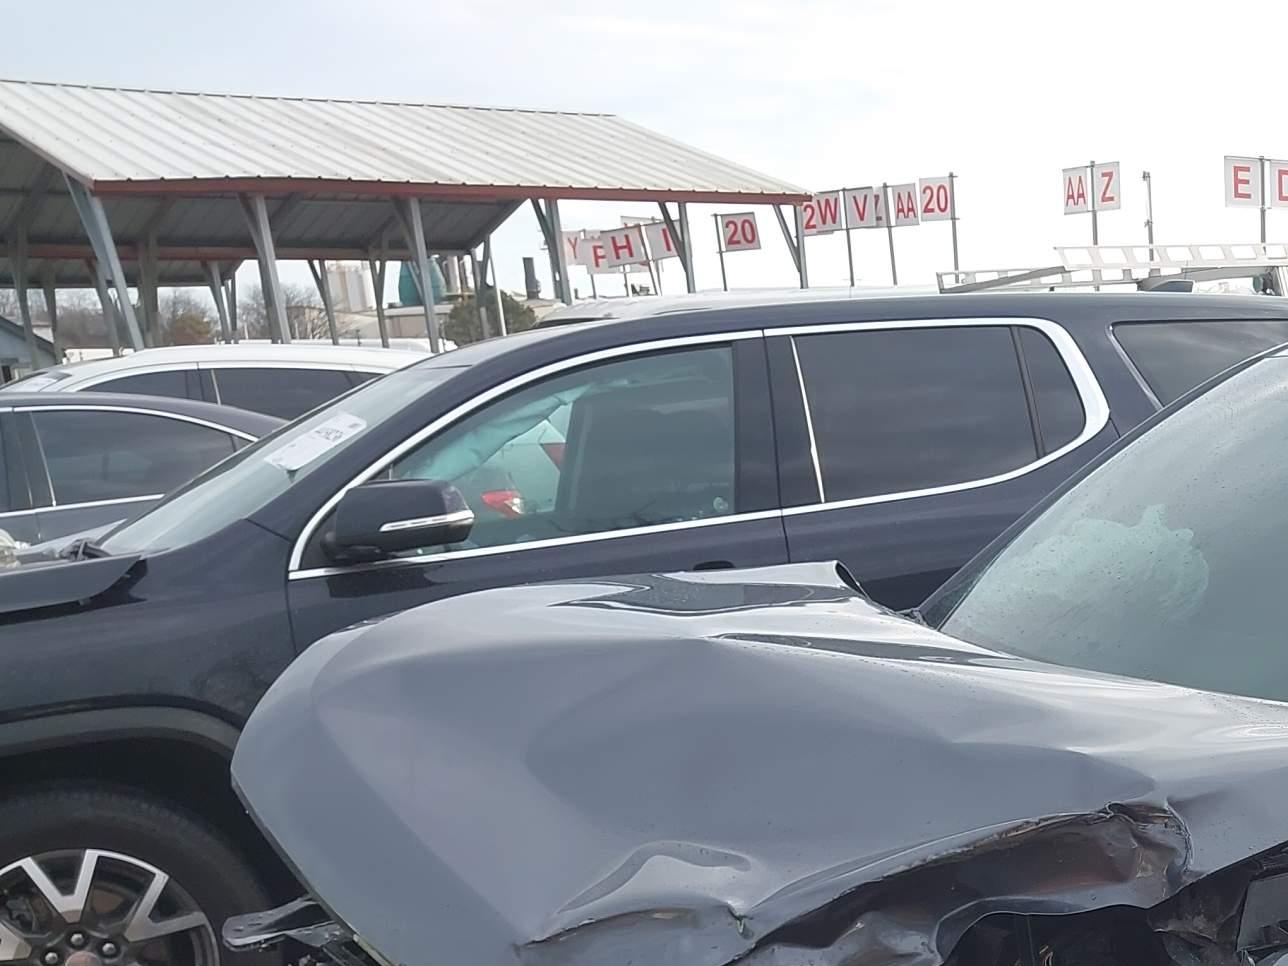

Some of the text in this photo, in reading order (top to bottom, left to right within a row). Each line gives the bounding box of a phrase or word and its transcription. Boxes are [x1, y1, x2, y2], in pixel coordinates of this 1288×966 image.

[1065, 171, 1115, 207] AA Z
[1233, 165, 1251, 199] E
[852, 194, 868, 222] V
[896, 191, 916, 220] AA
[922, 184, 949, 214] 20
[725, 218, 756, 246] 20
[567, 236, 578, 260] Y
[610, 233, 635, 260] H
